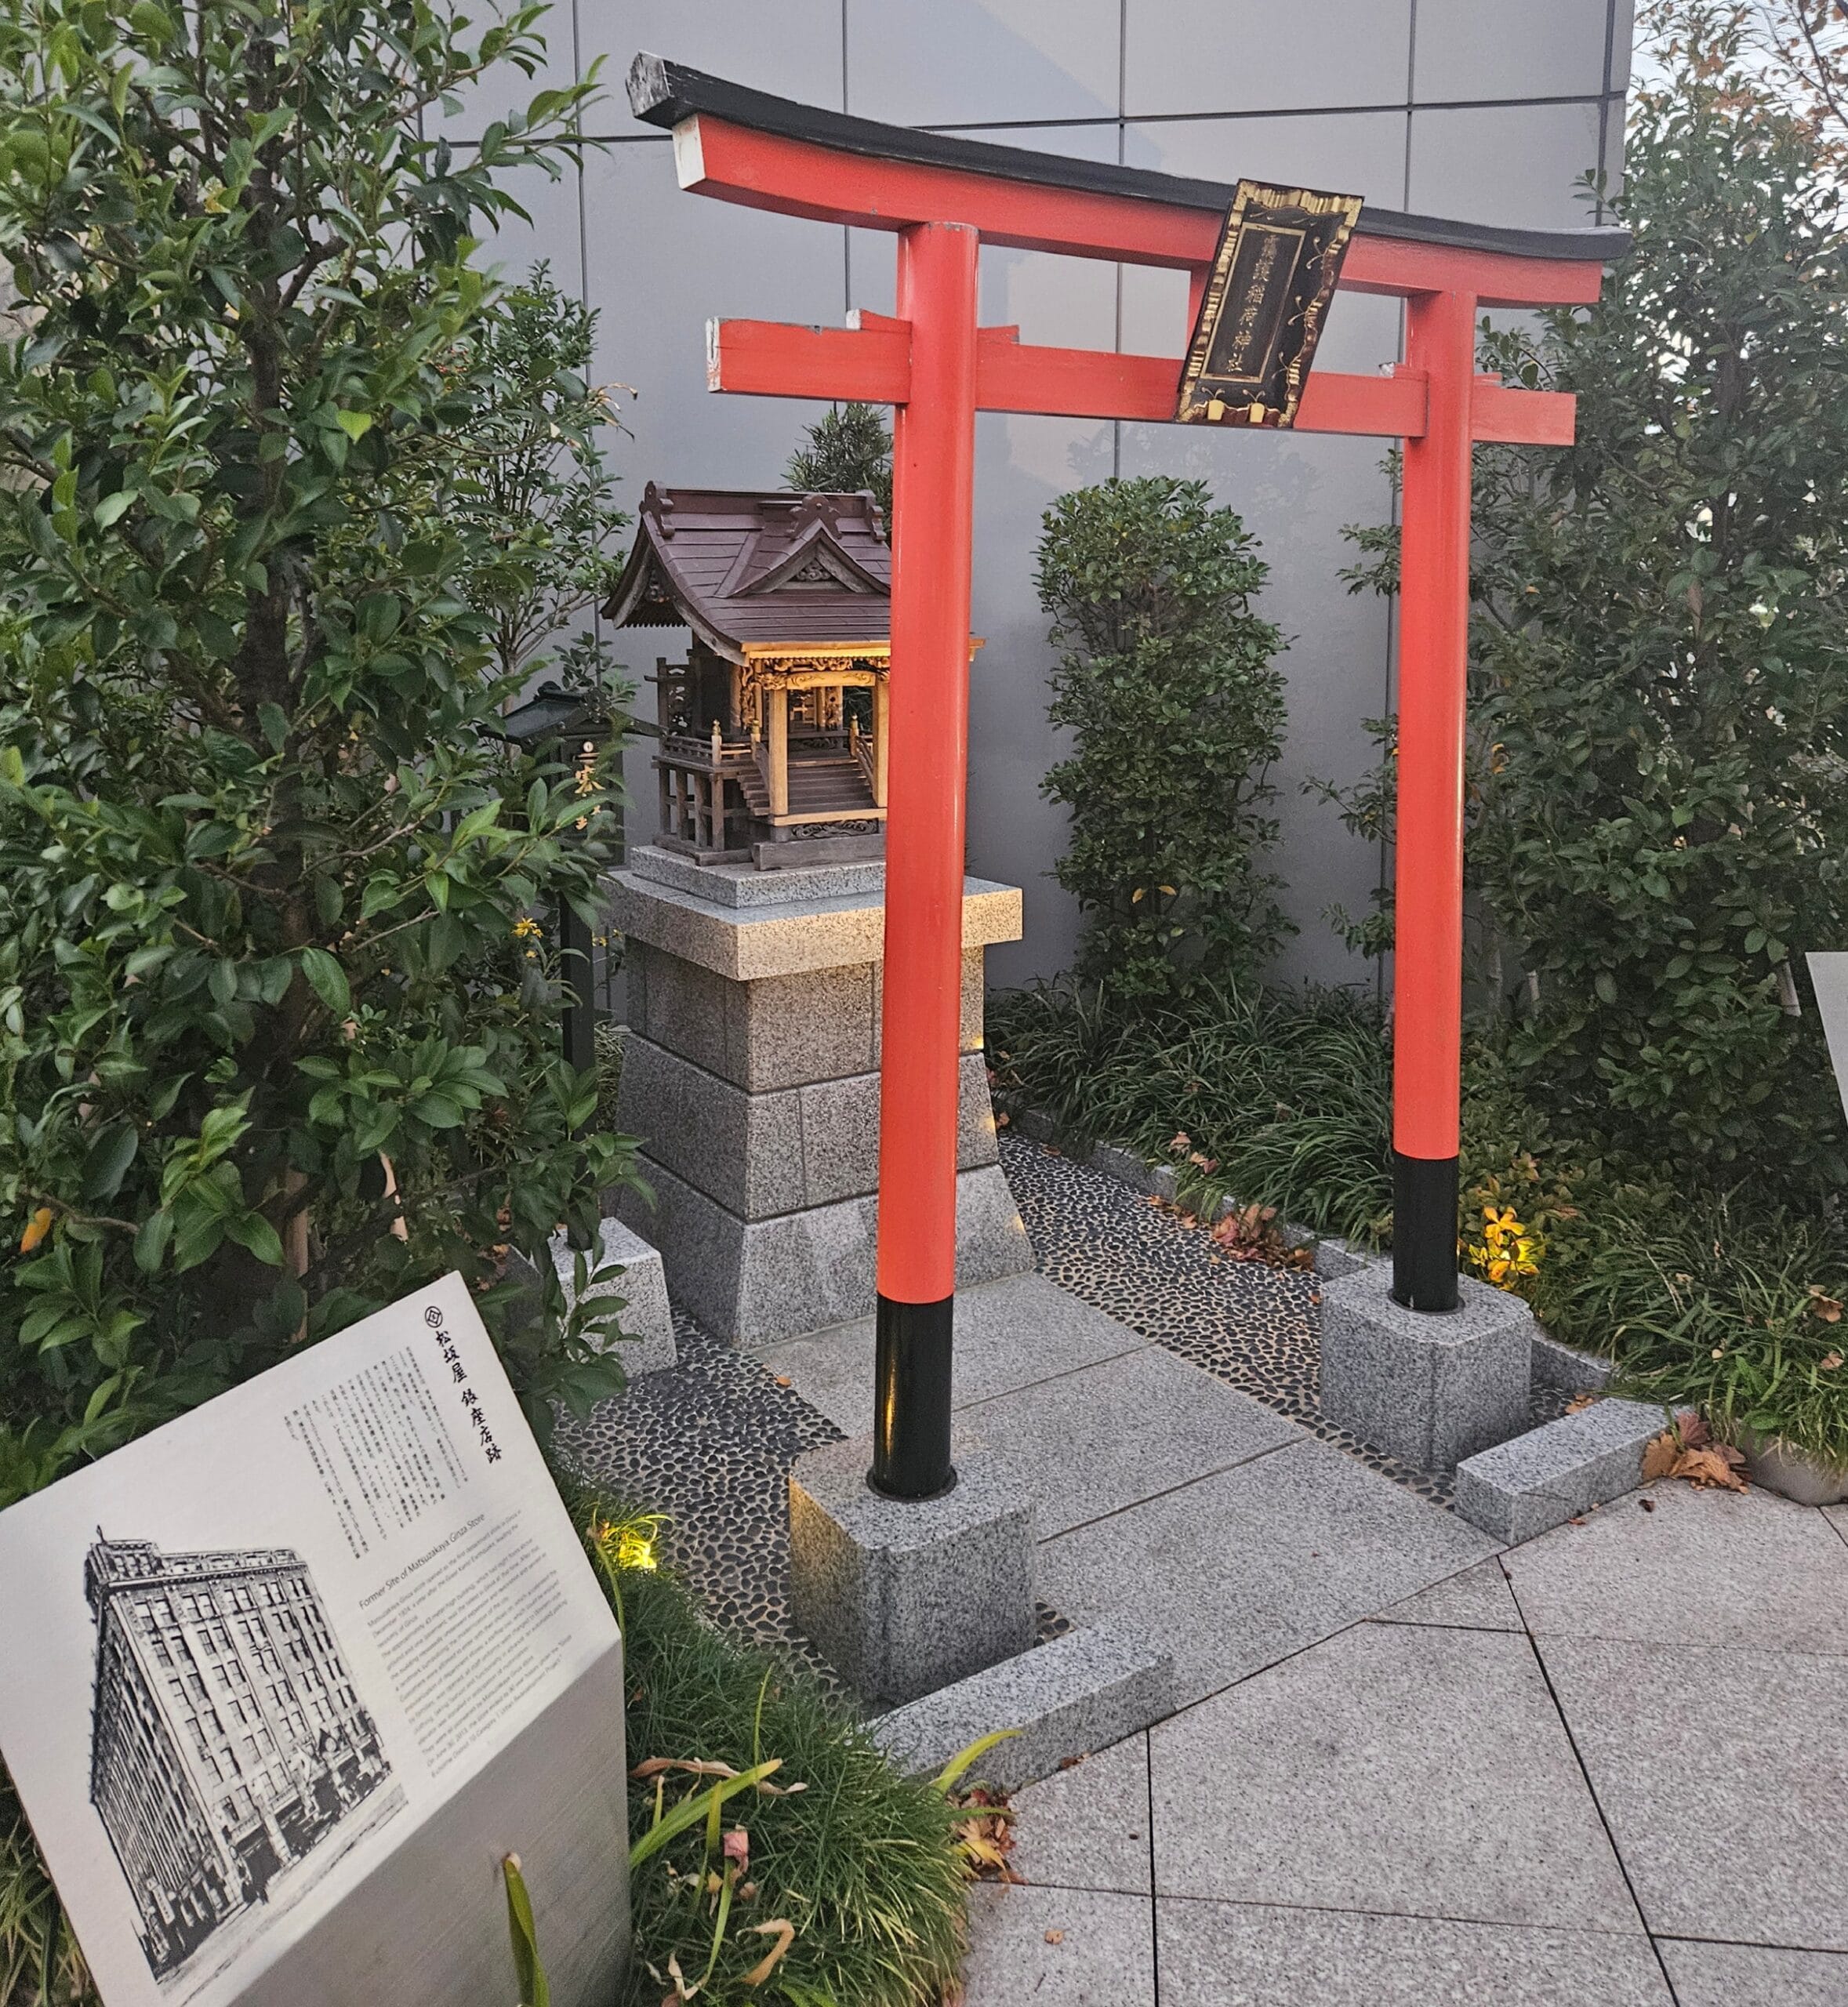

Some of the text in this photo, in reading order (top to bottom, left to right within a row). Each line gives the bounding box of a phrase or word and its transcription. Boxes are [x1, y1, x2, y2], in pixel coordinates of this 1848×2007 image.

[435, 1330, 468, 1384] 松坂屋
[461, 1388, 503, 1464] 銀座店跡
[358, 1510, 485, 1610] Former Site of Matsuzakaya Ginza Store
